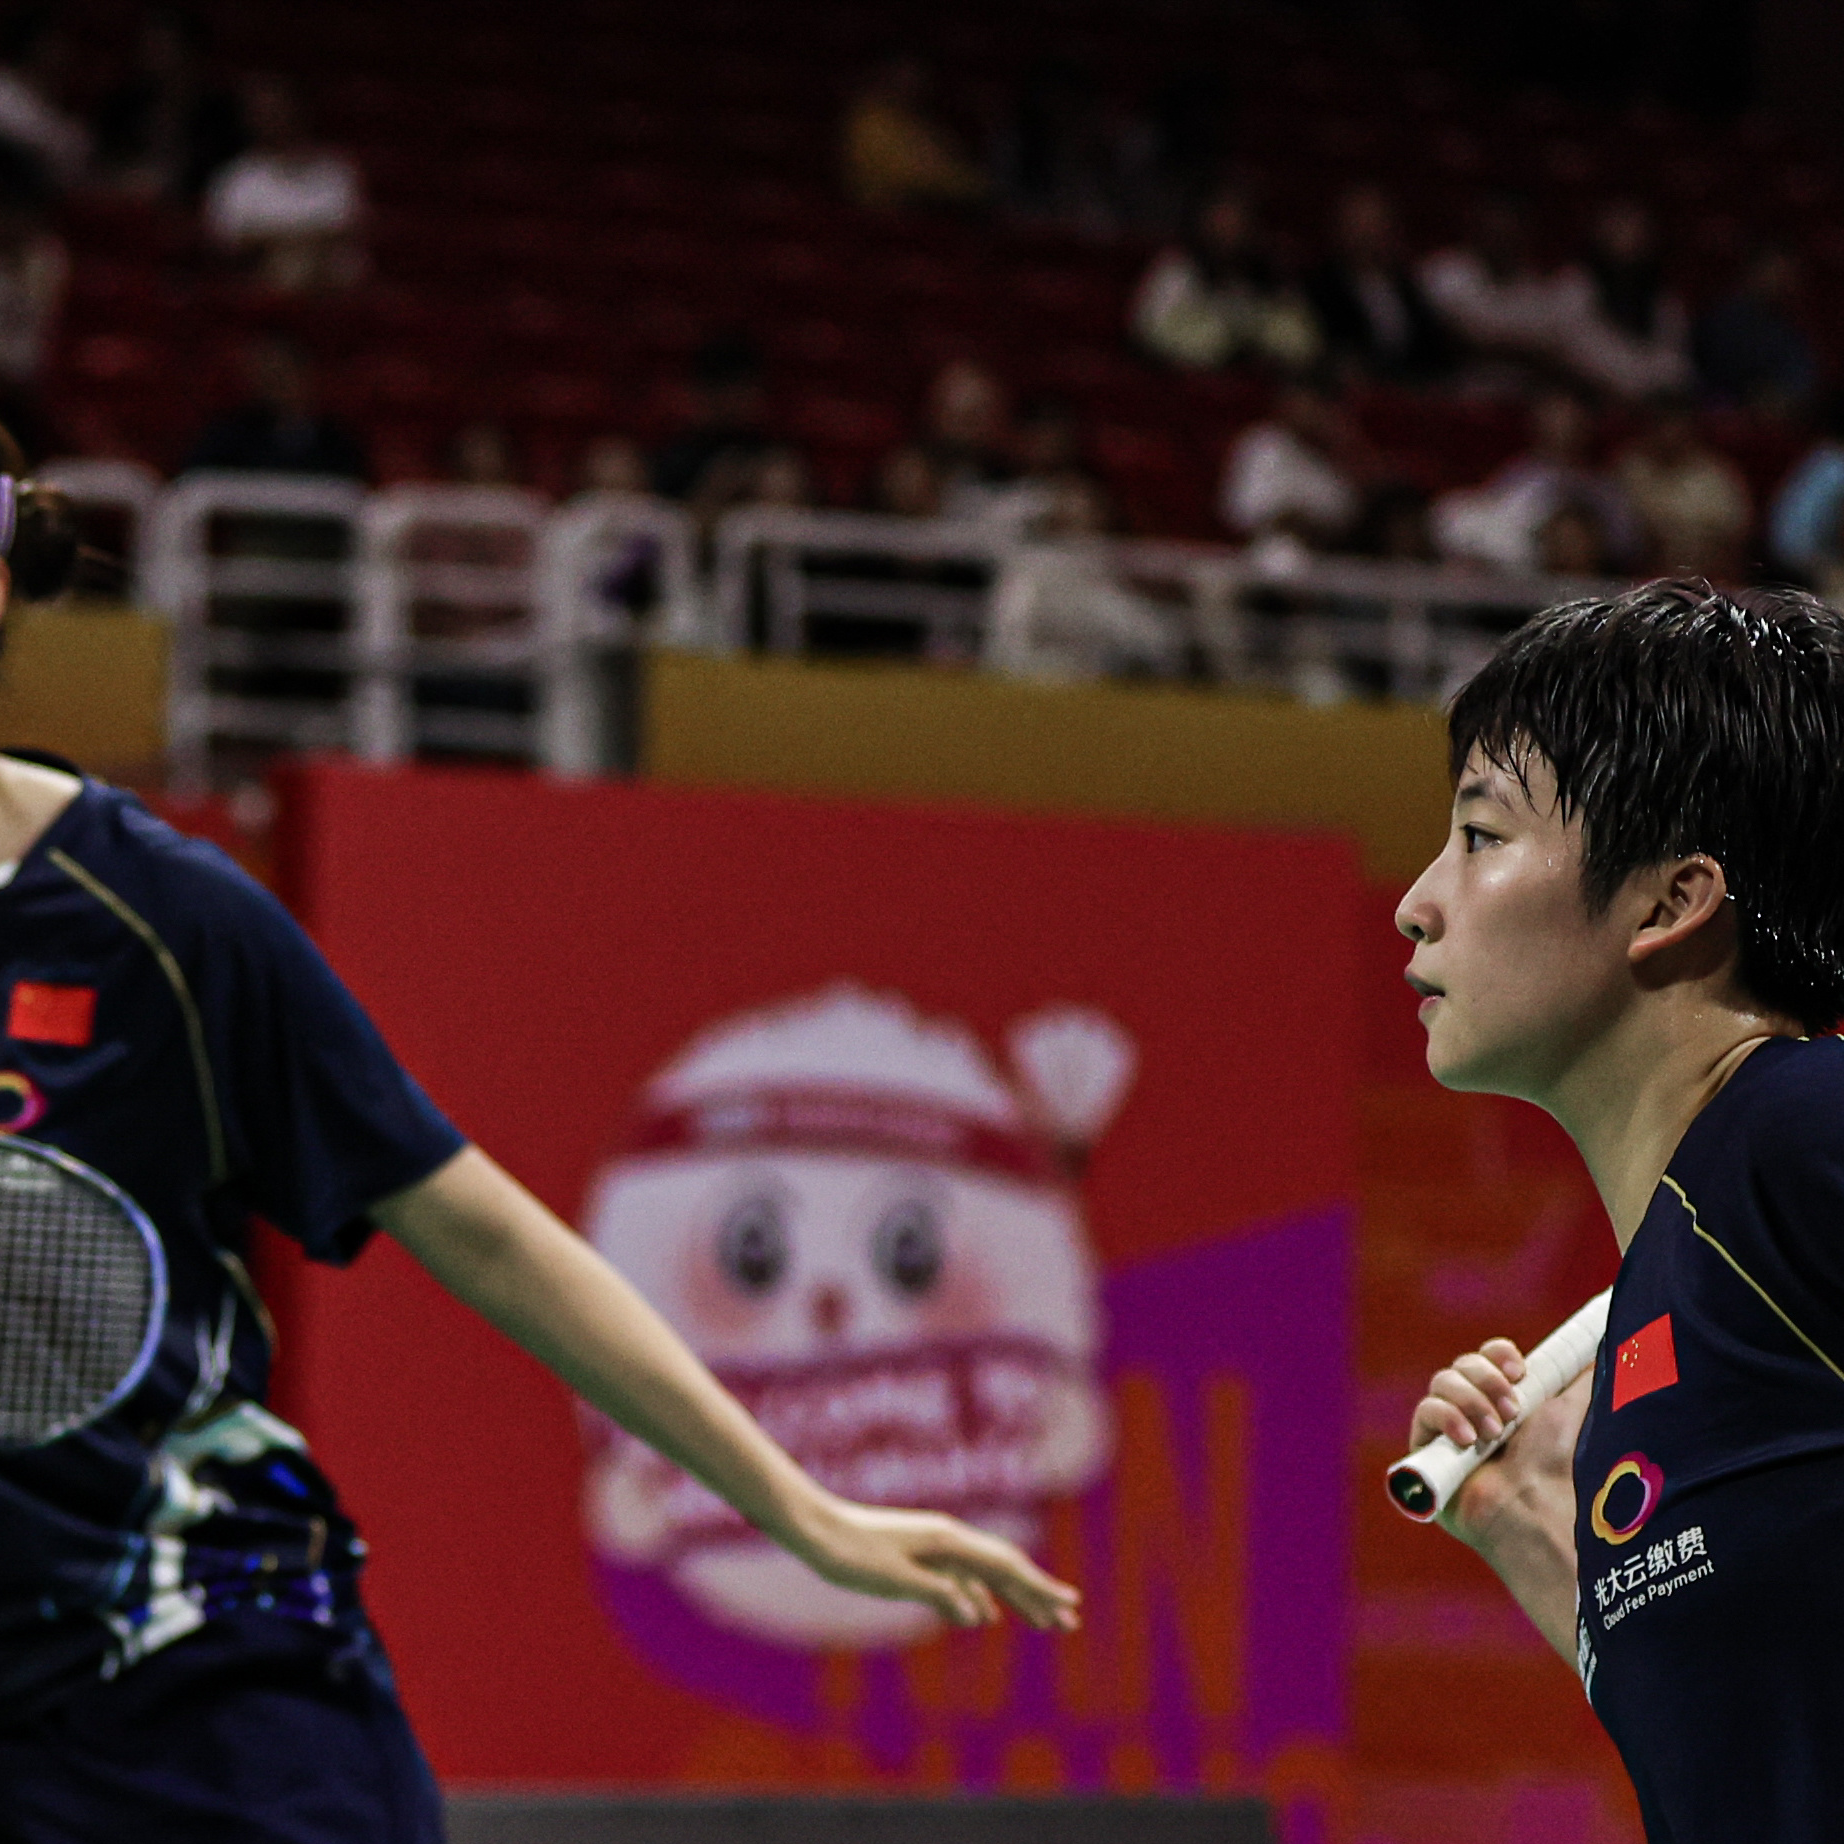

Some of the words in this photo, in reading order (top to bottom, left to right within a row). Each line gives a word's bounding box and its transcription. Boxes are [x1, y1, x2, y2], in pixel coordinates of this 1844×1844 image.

[1594, 1526, 1708, 1613] 光大云缴费
[1625, 1595, 1647, 1614] Fee
[1647, 1558, 1715, 1602] Payment
